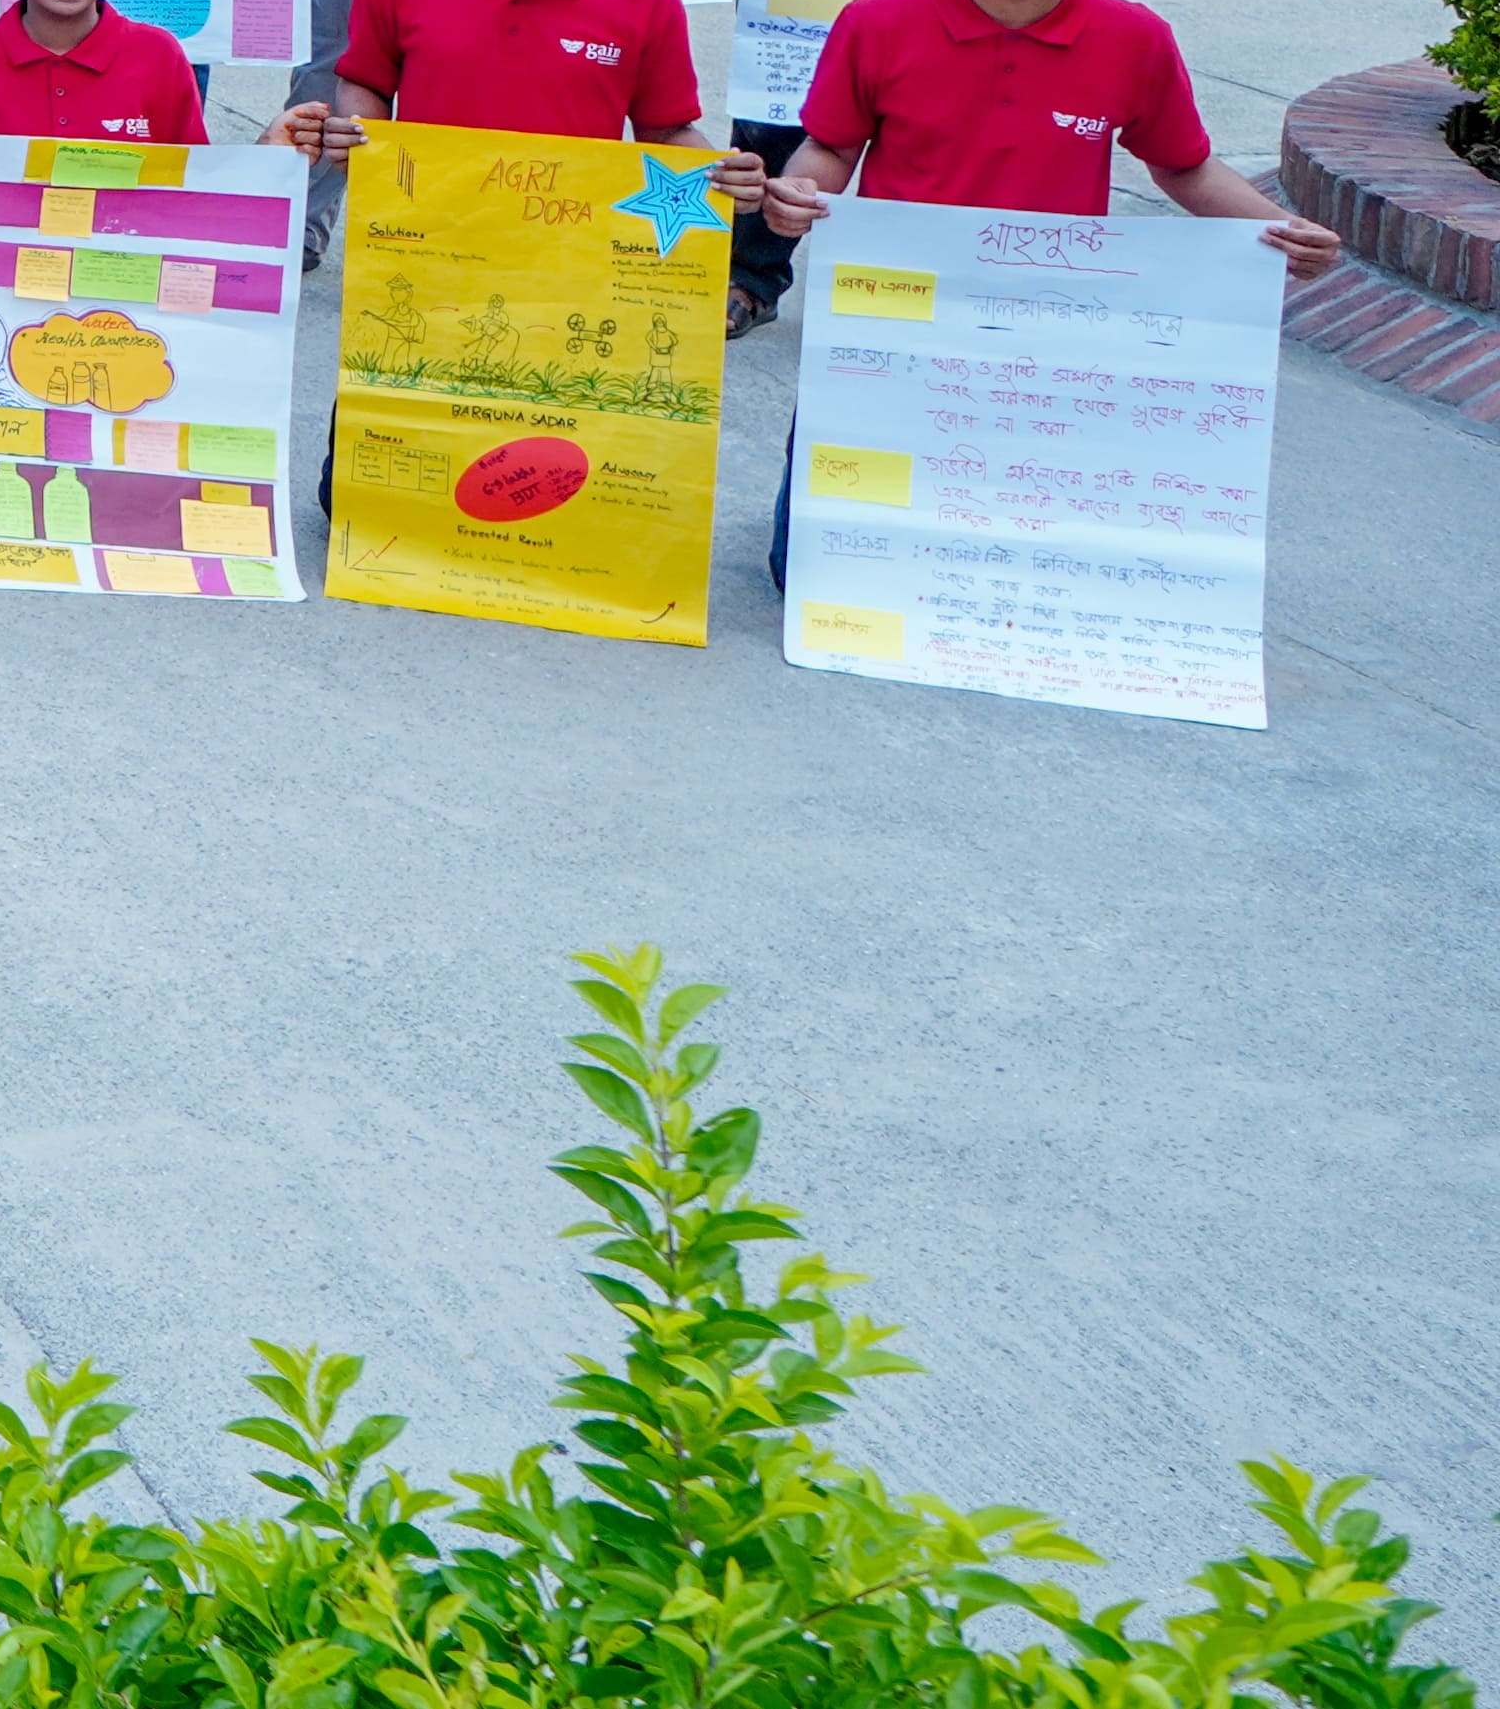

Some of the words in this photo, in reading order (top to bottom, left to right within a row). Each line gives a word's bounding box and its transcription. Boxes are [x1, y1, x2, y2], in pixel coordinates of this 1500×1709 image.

[586, 42, 620, 66] gain
[479, 156, 564, 194] AGRI
[521, 195, 594, 226] DORA
[451, 403, 525, 424] BARGUNA
[529, 412, 578, 432] SADAR
